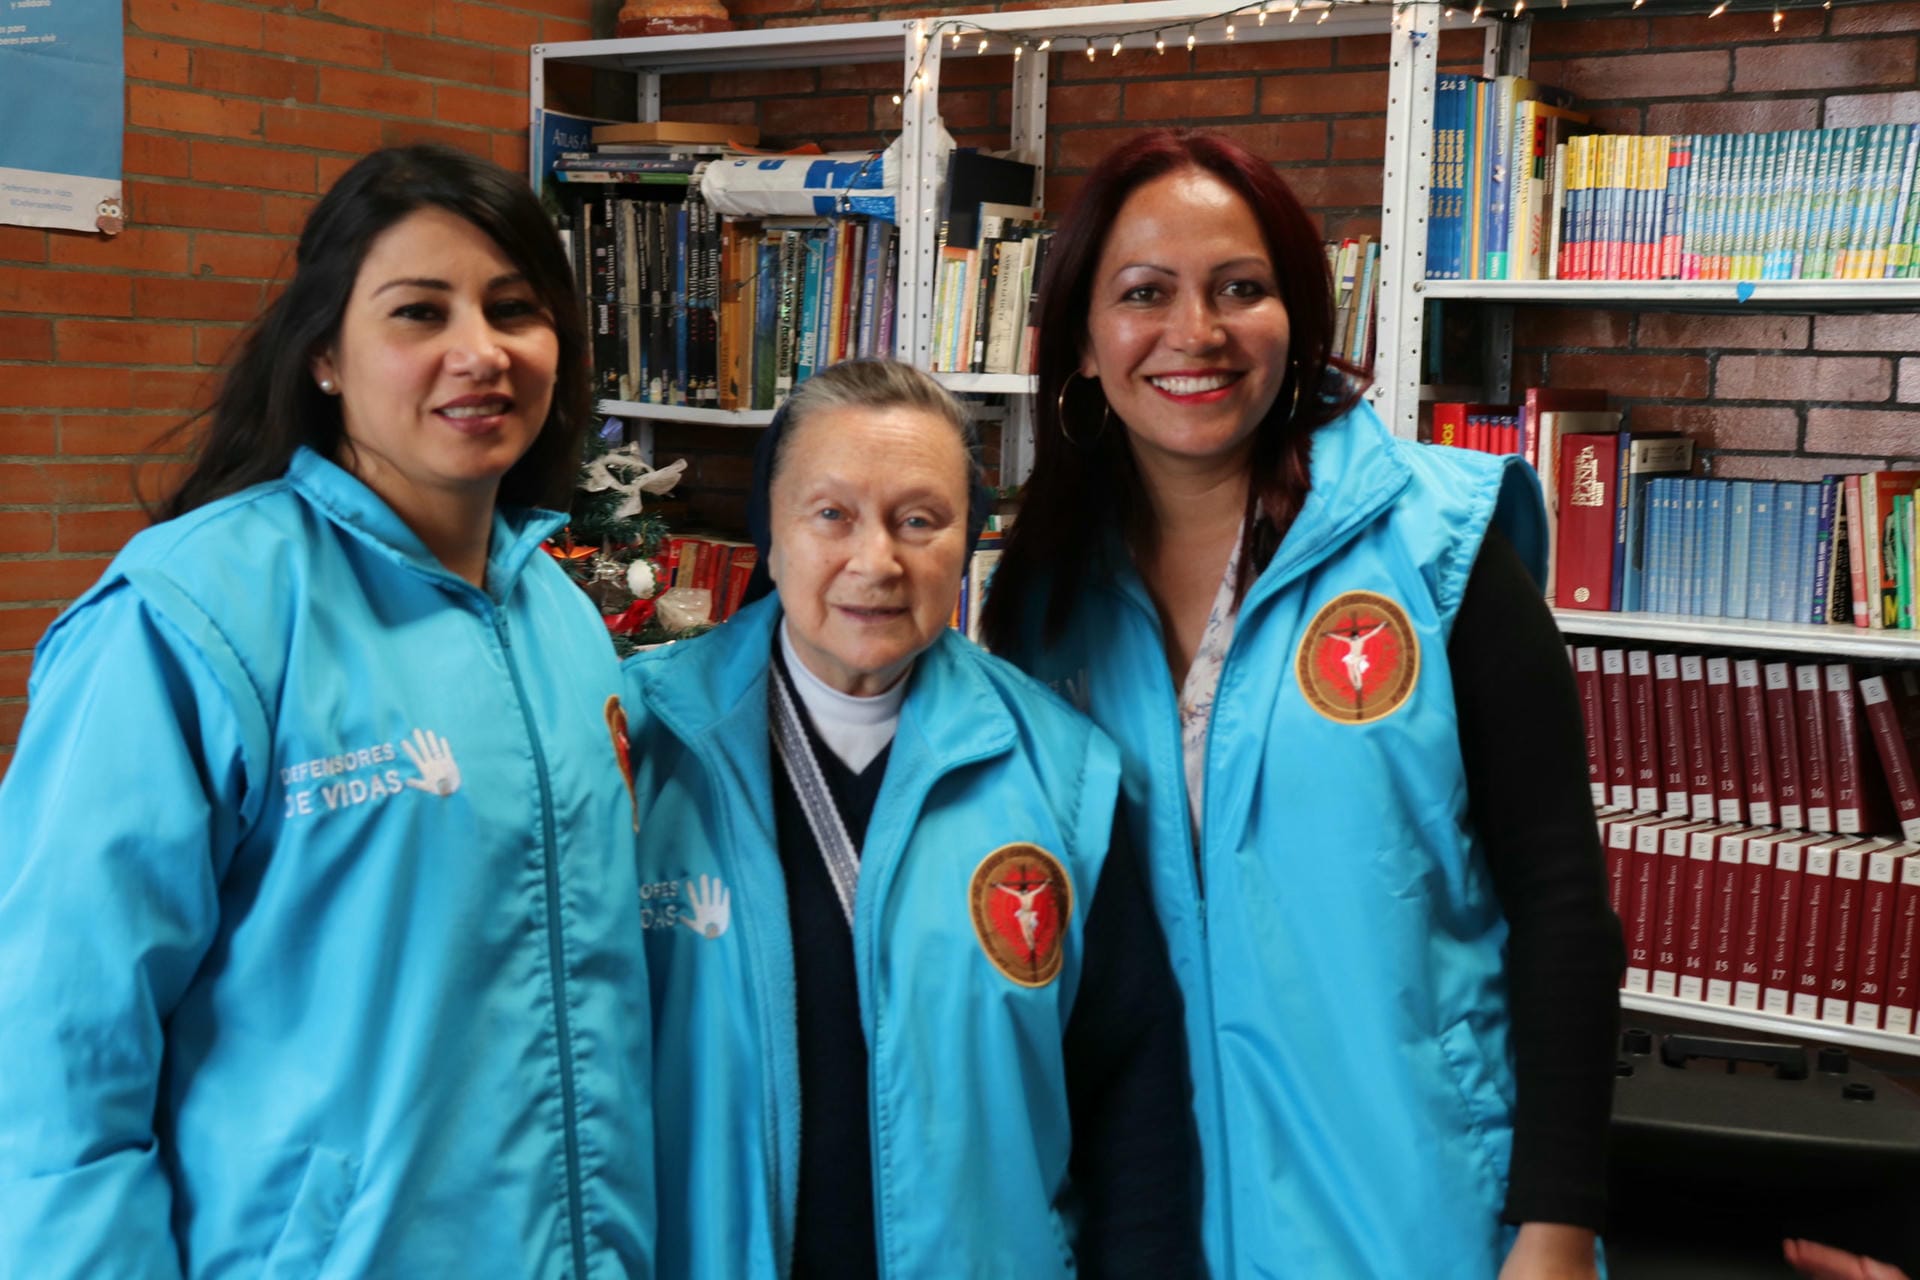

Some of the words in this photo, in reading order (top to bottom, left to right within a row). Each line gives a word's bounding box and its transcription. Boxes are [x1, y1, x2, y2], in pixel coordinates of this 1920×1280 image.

[280, 742, 395, 785] DEFENSORES
[1616, 766, 1624, 778] 9
[1640, 768, 1652, 780] 10
[1669, 772, 1680, 783] 11
[1695, 775, 1707, 786] 12
[1721, 780, 1734, 791] 13
[321, 769, 403, 810] VIDAS
[1752, 782, 1764, 793] 14
[1782, 785, 1794, 796] 15
[1811, 787, 1824, 799] 16
[1840, 789, 1852, 801] 17
[1632, 949, 1646, 960] 12
[1660, 952, 1673, 963] 13
[1687, 957, 1700, 968] 14
[1715, 959, 1728, 971] 15
[1743, 962, 1757, 974] 16
[1772, 968, 1786, 980] 17
[1801, 974, 1815, 985] 18
[1831, 979, 1845, 991] 19
[1860, 982, 1877, 994] 20
[1896, 987, 1904, 997] 7
